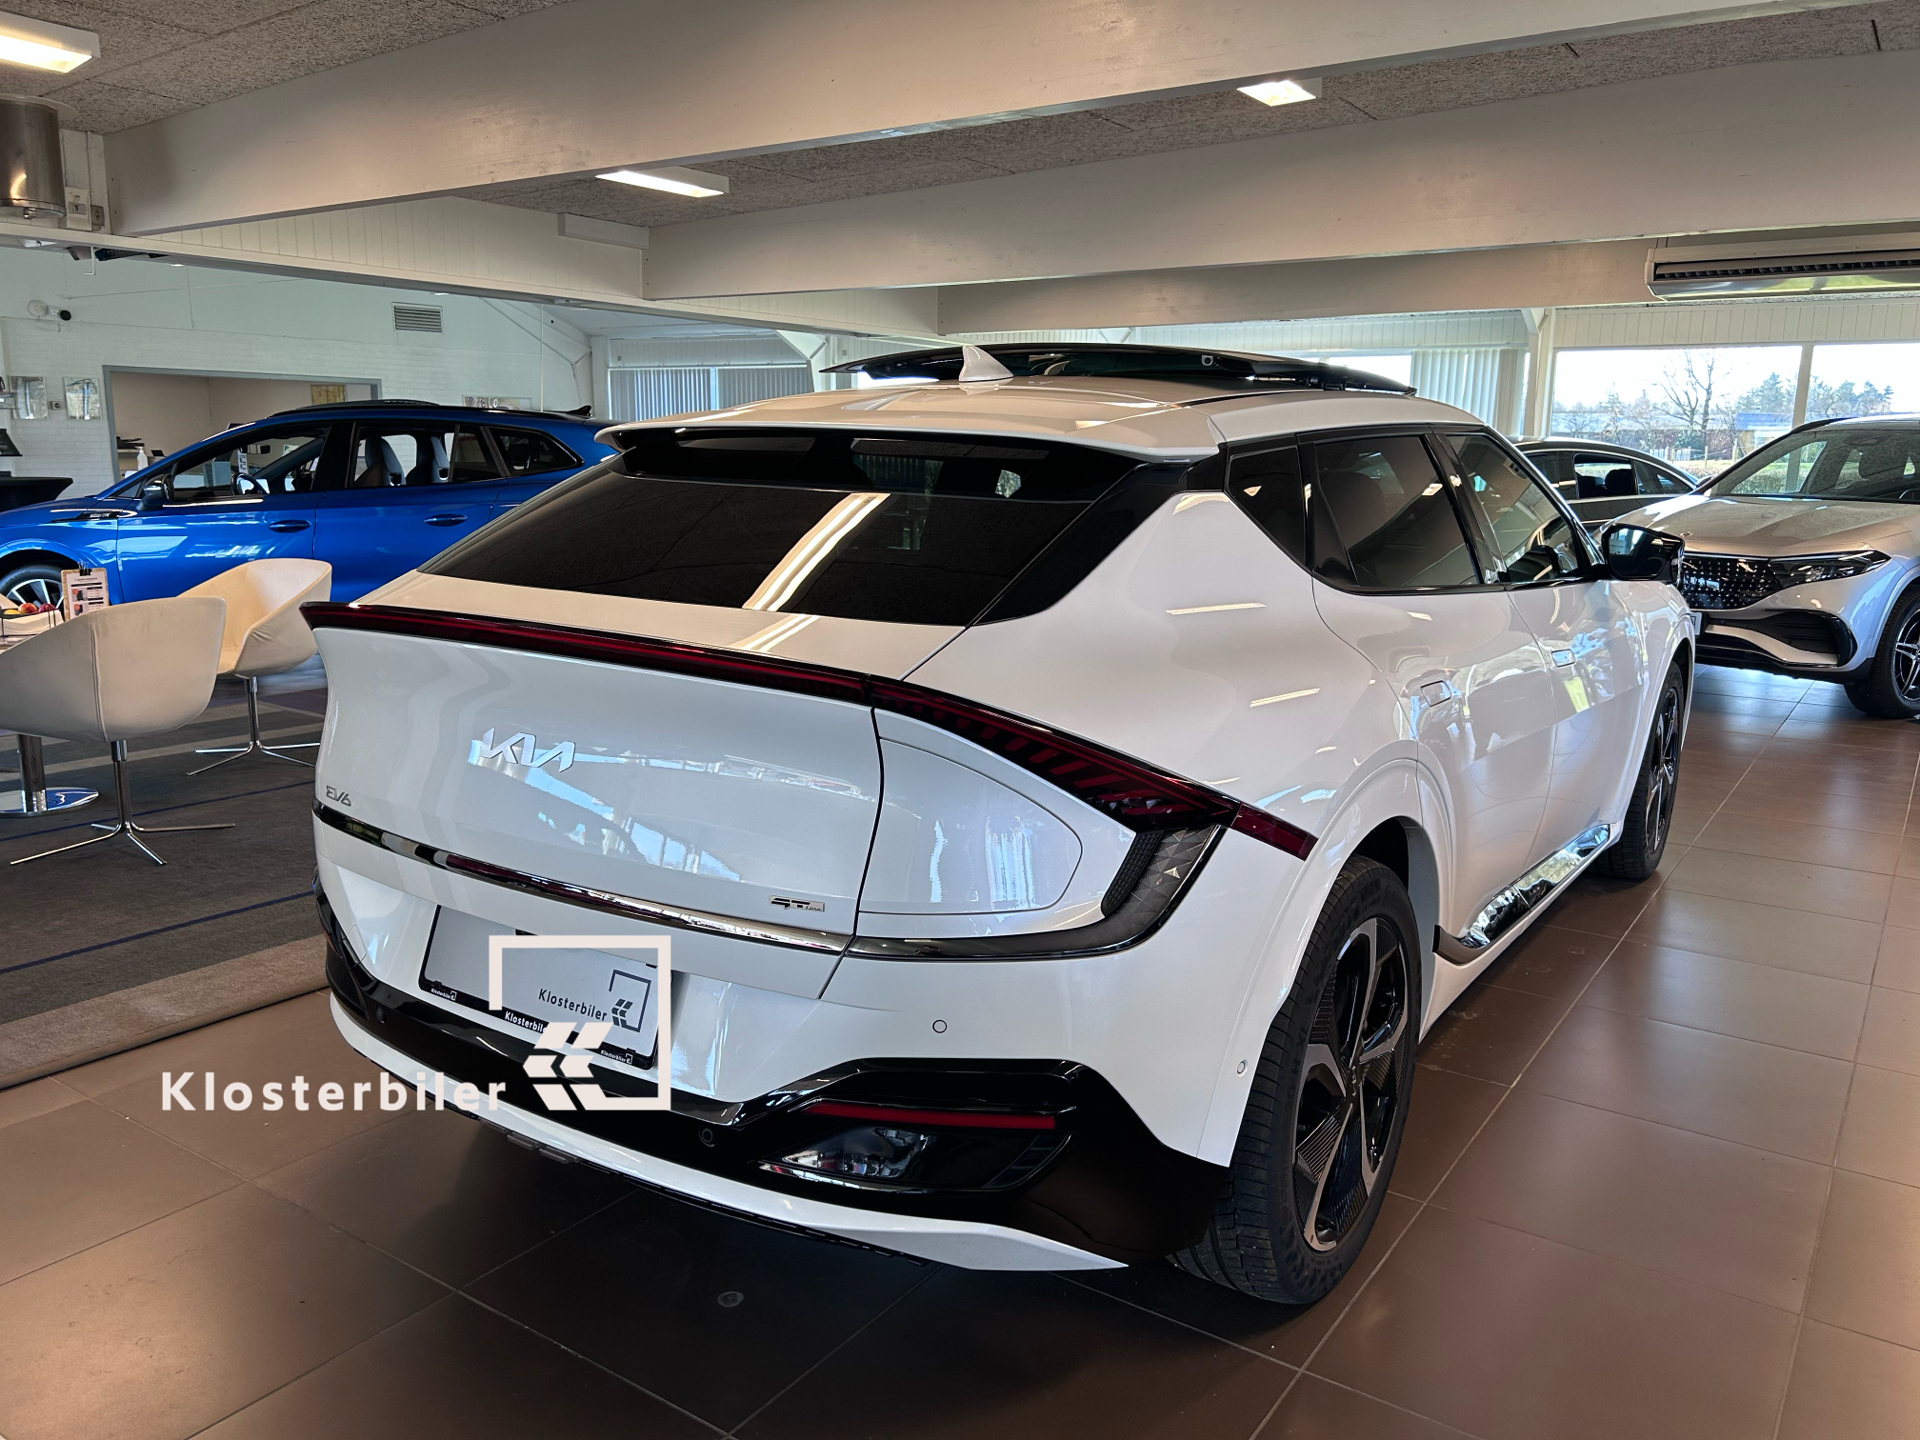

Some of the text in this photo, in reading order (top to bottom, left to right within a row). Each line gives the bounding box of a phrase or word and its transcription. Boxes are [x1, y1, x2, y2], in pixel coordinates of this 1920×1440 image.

[481, 727, 576, 773] KIA
[326, 785, 352, 807] EV6
[538, 988, 608, 1021] Klosterbiler
[504, 1011, 548, 1033] Klosterbil
